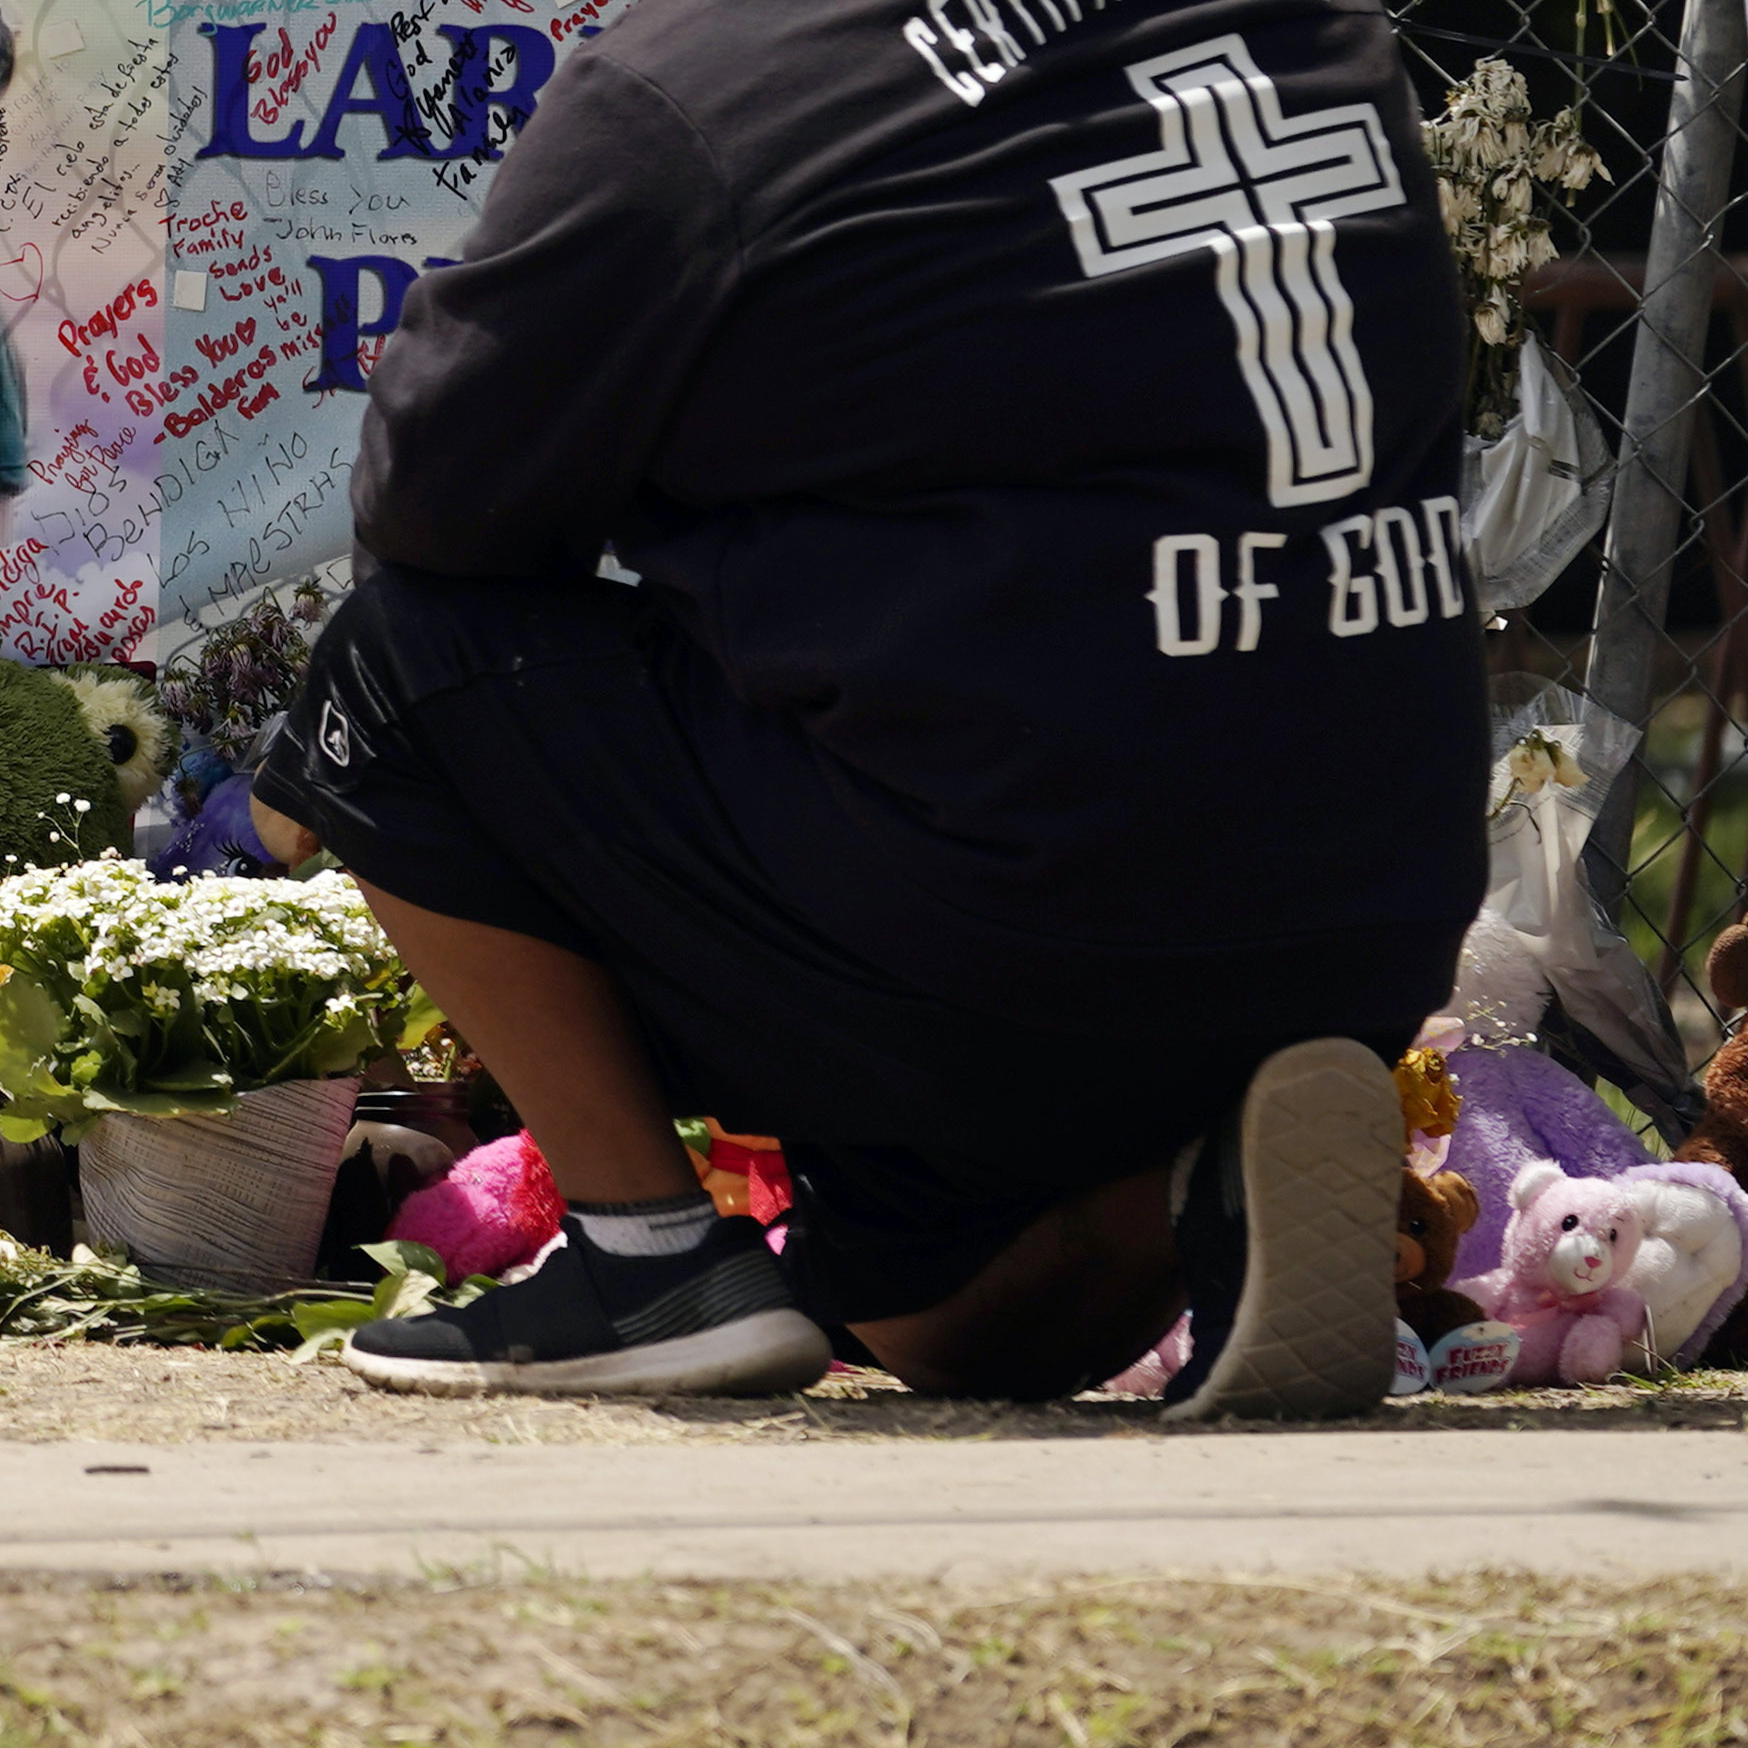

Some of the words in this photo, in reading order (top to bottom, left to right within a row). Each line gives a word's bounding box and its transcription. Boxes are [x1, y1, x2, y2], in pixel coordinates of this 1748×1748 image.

[244, 27, 295, 84] God
[58, 278, 159, 357] Prayers
[108, 333, 161, 391] God
[124, 362, 200, 419] Bless
[1143, 532, 1287, 656] OF
[1320, 496, 1465, 638] GOD
[1434, 1357, 1508, 1384] FRIENDS
[1448, 1342, 1508, 1364] FUZZY
